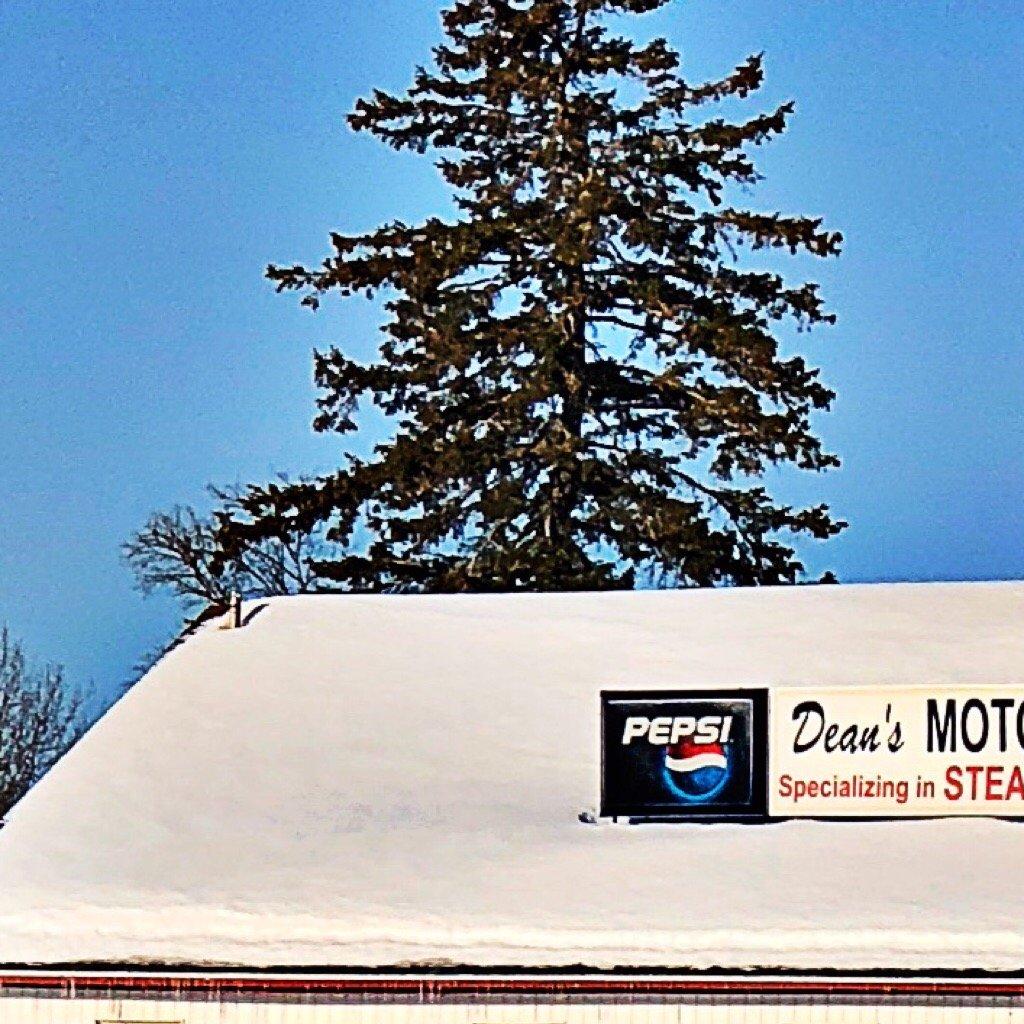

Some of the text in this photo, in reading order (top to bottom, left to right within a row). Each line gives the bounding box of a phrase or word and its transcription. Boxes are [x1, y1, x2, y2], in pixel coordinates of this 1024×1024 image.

[622, 716, 733, 745] PEPSI
[792, 701, 905, 753] Dean's
[779, 774, 908, 803] Specializing
[916, 775, 934, 797] in
